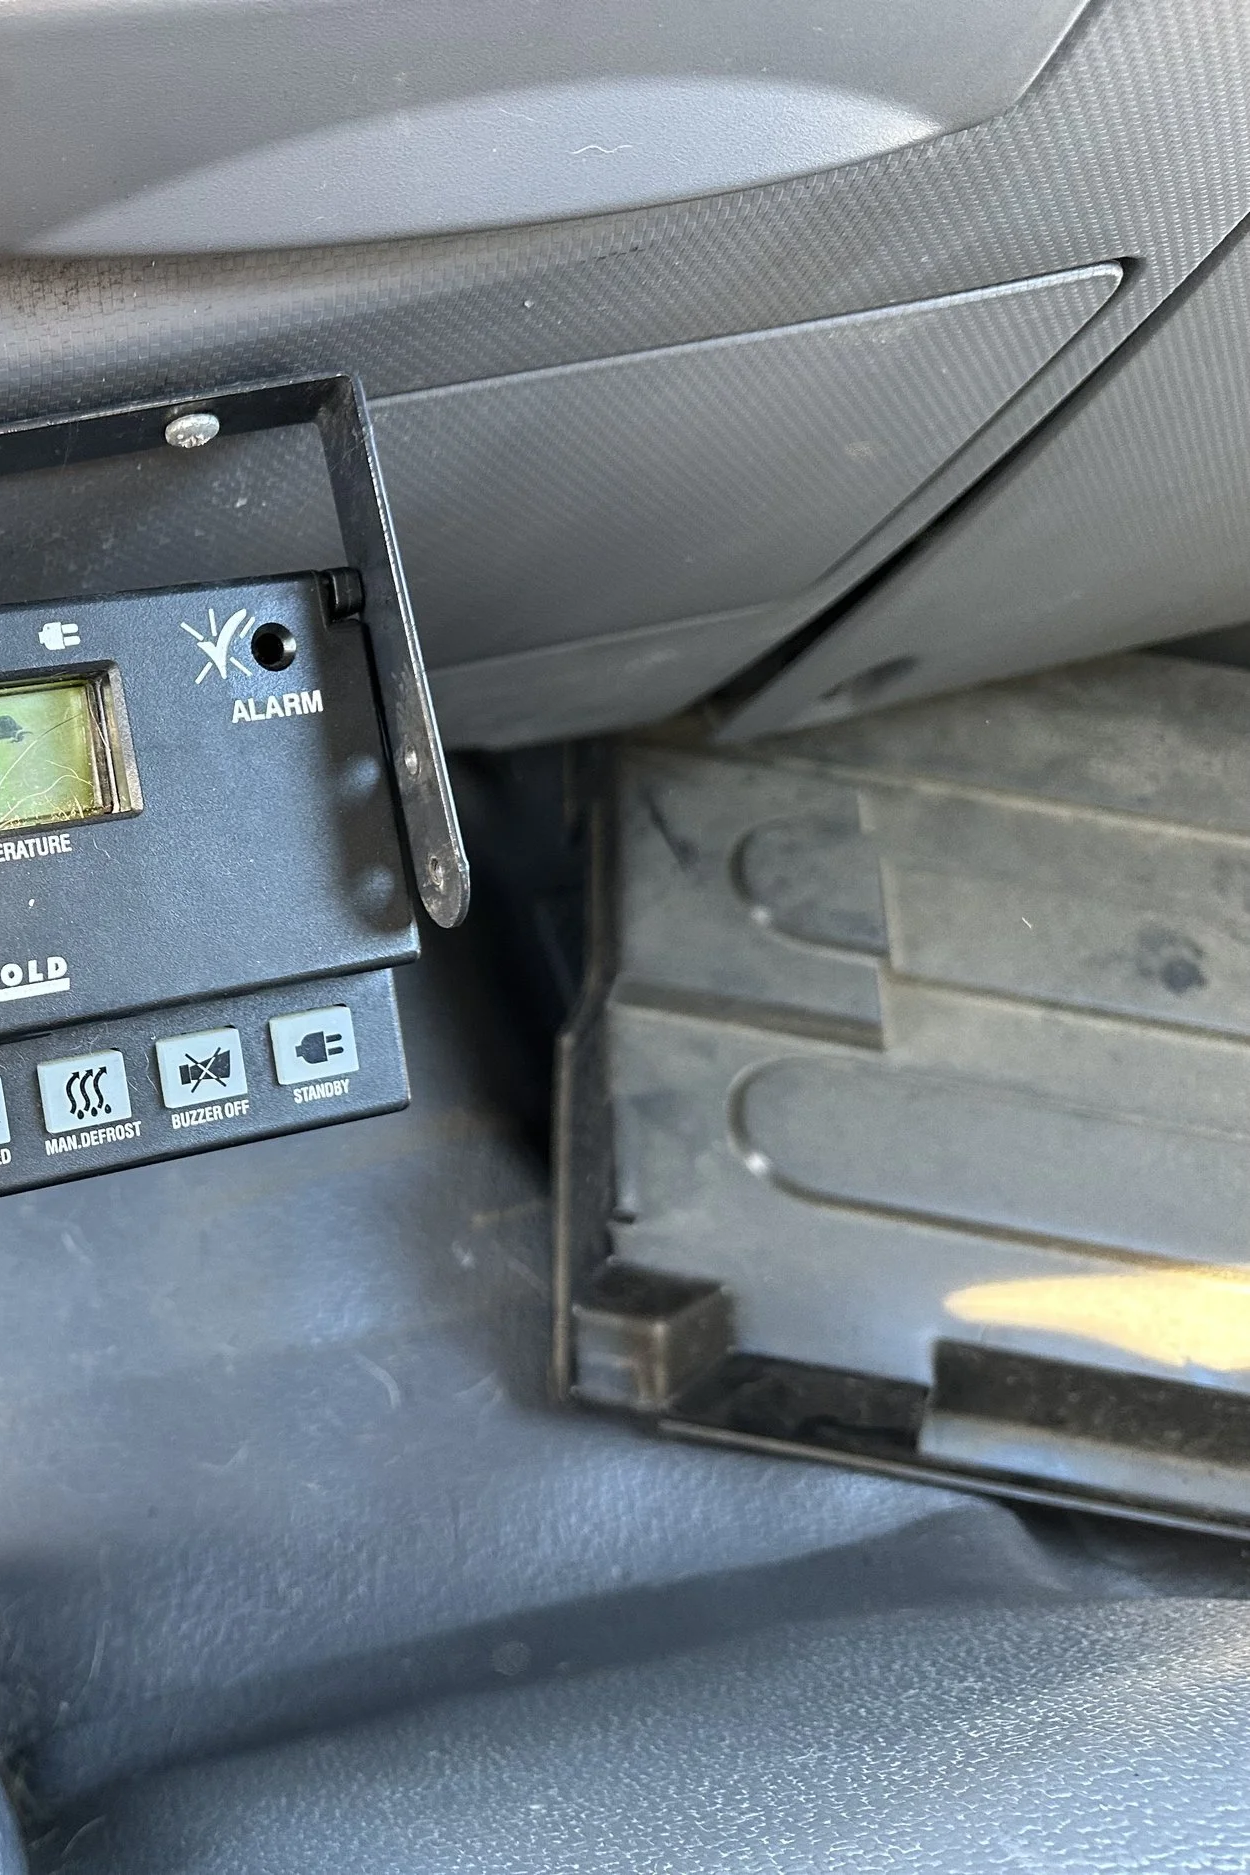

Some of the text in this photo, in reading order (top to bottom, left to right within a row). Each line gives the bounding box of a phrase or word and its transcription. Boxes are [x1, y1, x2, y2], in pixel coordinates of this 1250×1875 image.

[231, 689, 324, 723] ALARM
[293, 1078, 350, 1104] STANDBY
[171, 1099, 250, 1130] BUZZER OFF
[45, 1120, 142, 1156] MAN.DEFROST
